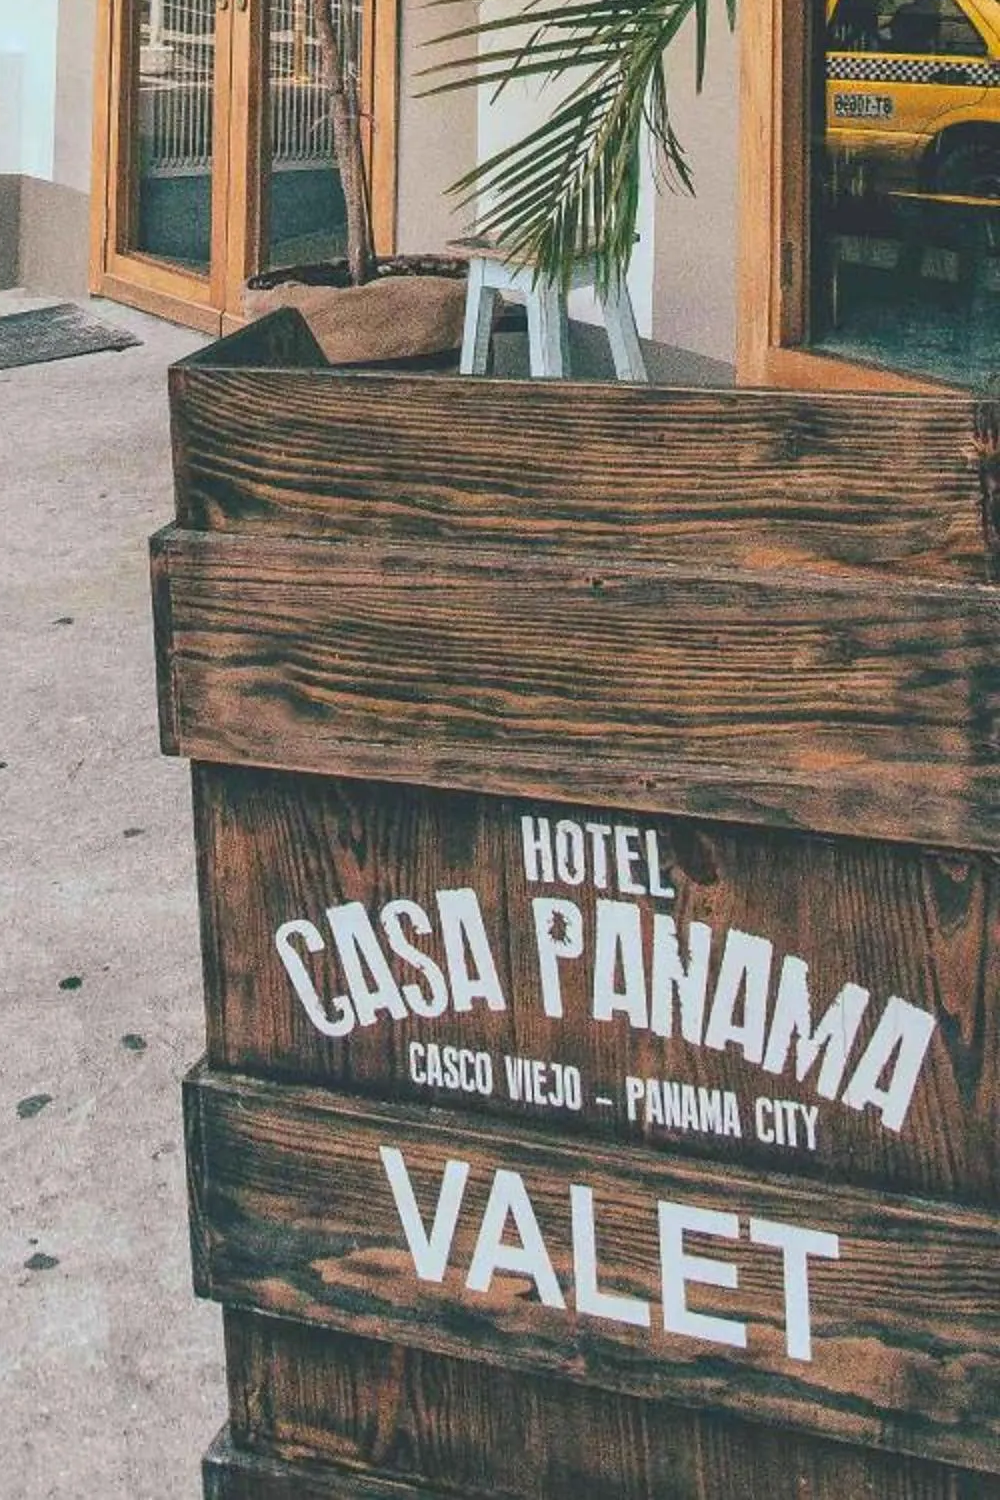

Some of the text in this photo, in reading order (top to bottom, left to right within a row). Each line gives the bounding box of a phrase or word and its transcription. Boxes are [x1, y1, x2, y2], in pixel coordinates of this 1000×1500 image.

[521, 816, 675, 898] HOTEL
[275, 887, 935, 1132] CASA PANAMA
[408, 1041, 493, 1096] CASCO
[504, 1053, 582, 1111] VIEJO
[626, 1076, 741, 1139] PANAMA
[755, 1100, 819, 1151] CITY
[378, 1145, 841, 1362] VALET
